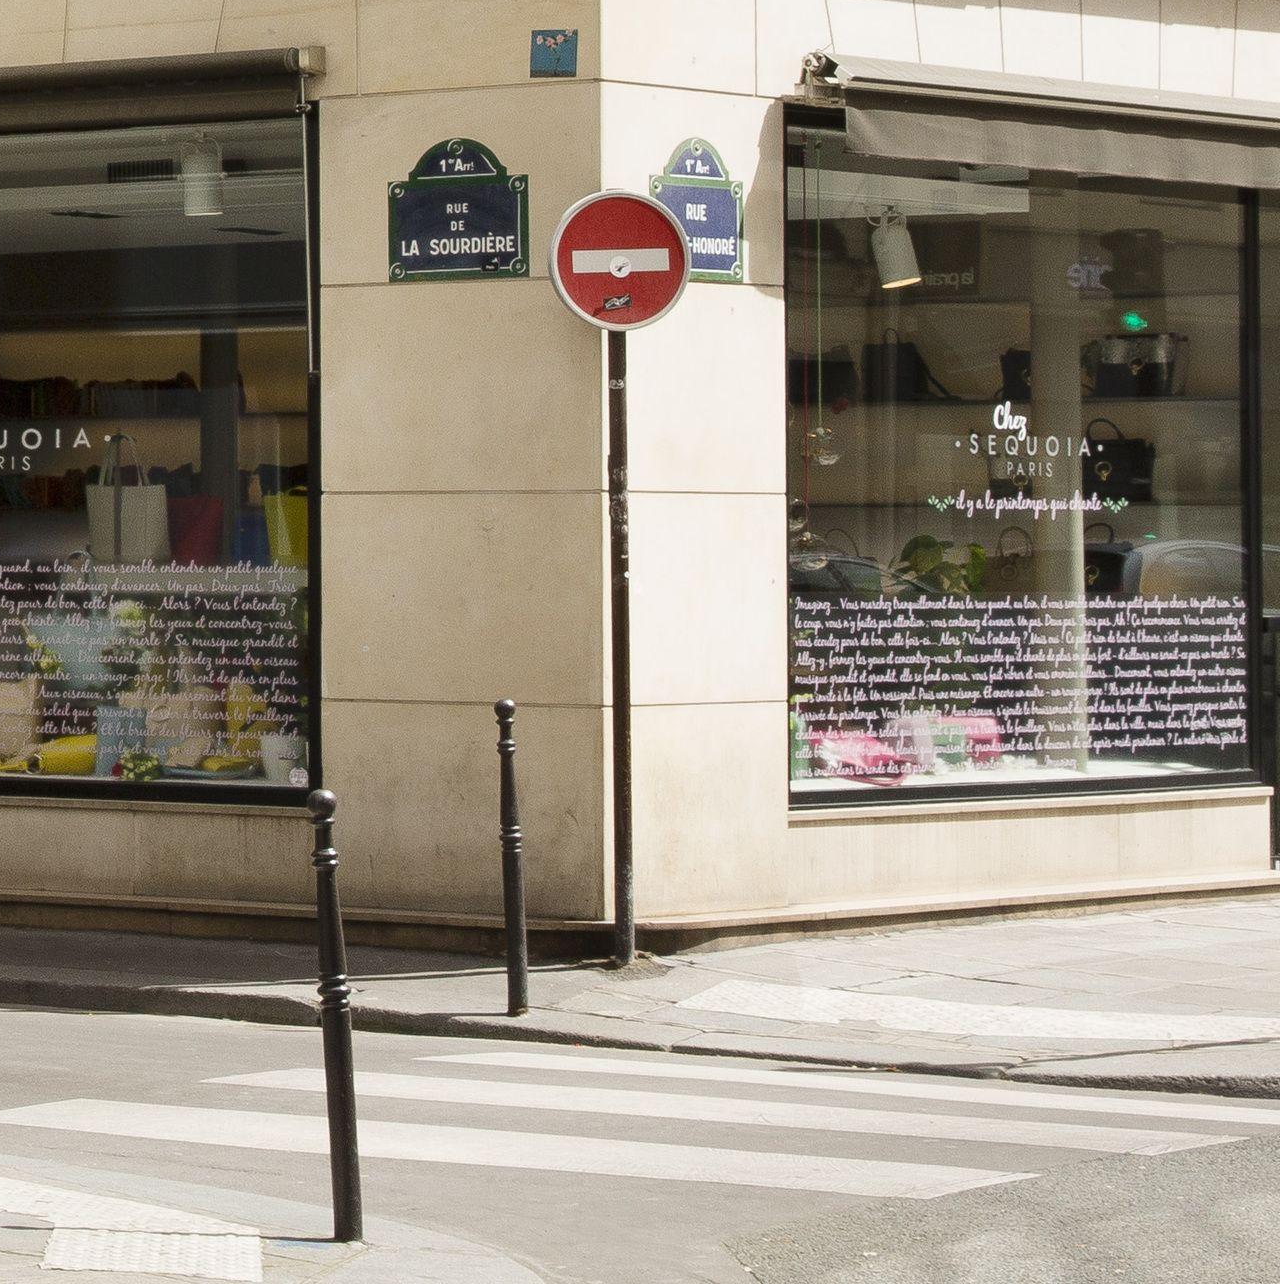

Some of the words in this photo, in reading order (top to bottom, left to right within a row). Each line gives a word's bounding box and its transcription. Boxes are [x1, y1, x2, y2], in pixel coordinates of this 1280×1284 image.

[446, 203, 469, 214] RUE
[686, 203, 707, 221] RUE
[450, 220, 465, 231] DE
[401, 239, 420, 256] LA
[429, 231, 515, 256] SOURDIÈRE
[993, 401, 1027, 441] Chez
[969, 433, 1092, 457] SEQUOIA
[1006, 461, 1053, 478] PARIS
[955, 489, 966, 510] il
[967, 497, 974, 518] y
[985, 489, 996, 510] le
[995, 491, 1048, 520] printemps
[1050, 497, 1068, 520] qui
[1068, 489, 1102, 511] chante
[120, 558, 158, 573] semble
[160, 559, 206, 573] entendre
[225, 560, 253, 580] petit
[254, 559, 299, 581] quelque
[34, 582, 58, 591] vous
[60, 577, 108, 596] continuez
[267, 579, 298, 592] Trois
[17, 599, 42, 614] pour
[83, 596, 107, 609] cette
[158, 596, 191, 610] Alors
[203, 598, 231, 610] Vous
[149, 613, 165, 628] les
[168, 620, 193, 633] yeux
[192, 637, 240, 654] musique
[242, 633, 285, 652] grandit
[168, 651, 212, 670] entendez
[232, 652, 262, 666] autre
[263, 659, 299, 667] oiseau
